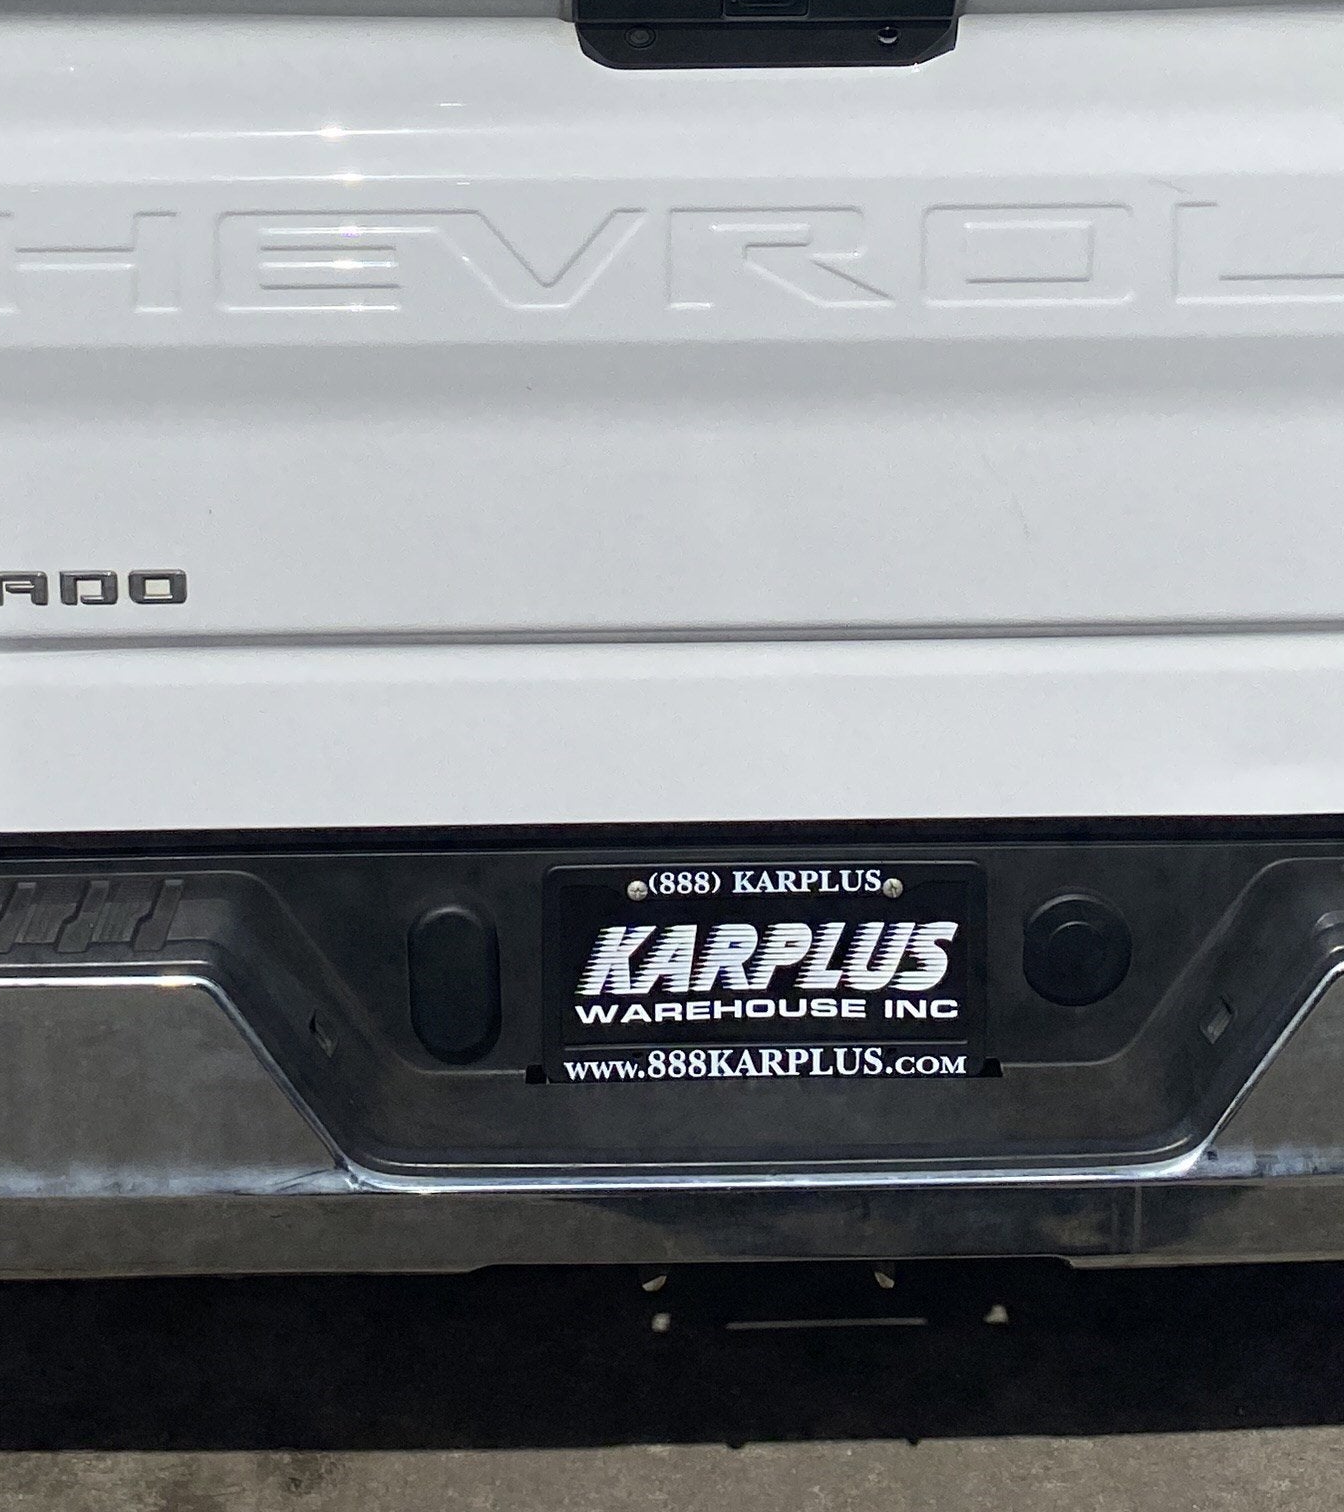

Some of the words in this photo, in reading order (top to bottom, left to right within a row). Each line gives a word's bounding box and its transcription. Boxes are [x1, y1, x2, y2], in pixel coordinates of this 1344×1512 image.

[648, 871, 721, 895] (888)
[732, 869, 882, 893] KARPLUS
[574, 921, 959, 995] KARPLUS
[574, 998, 867, 1024] WAREHOUSE
[884, 999, 959, 1019] INC
